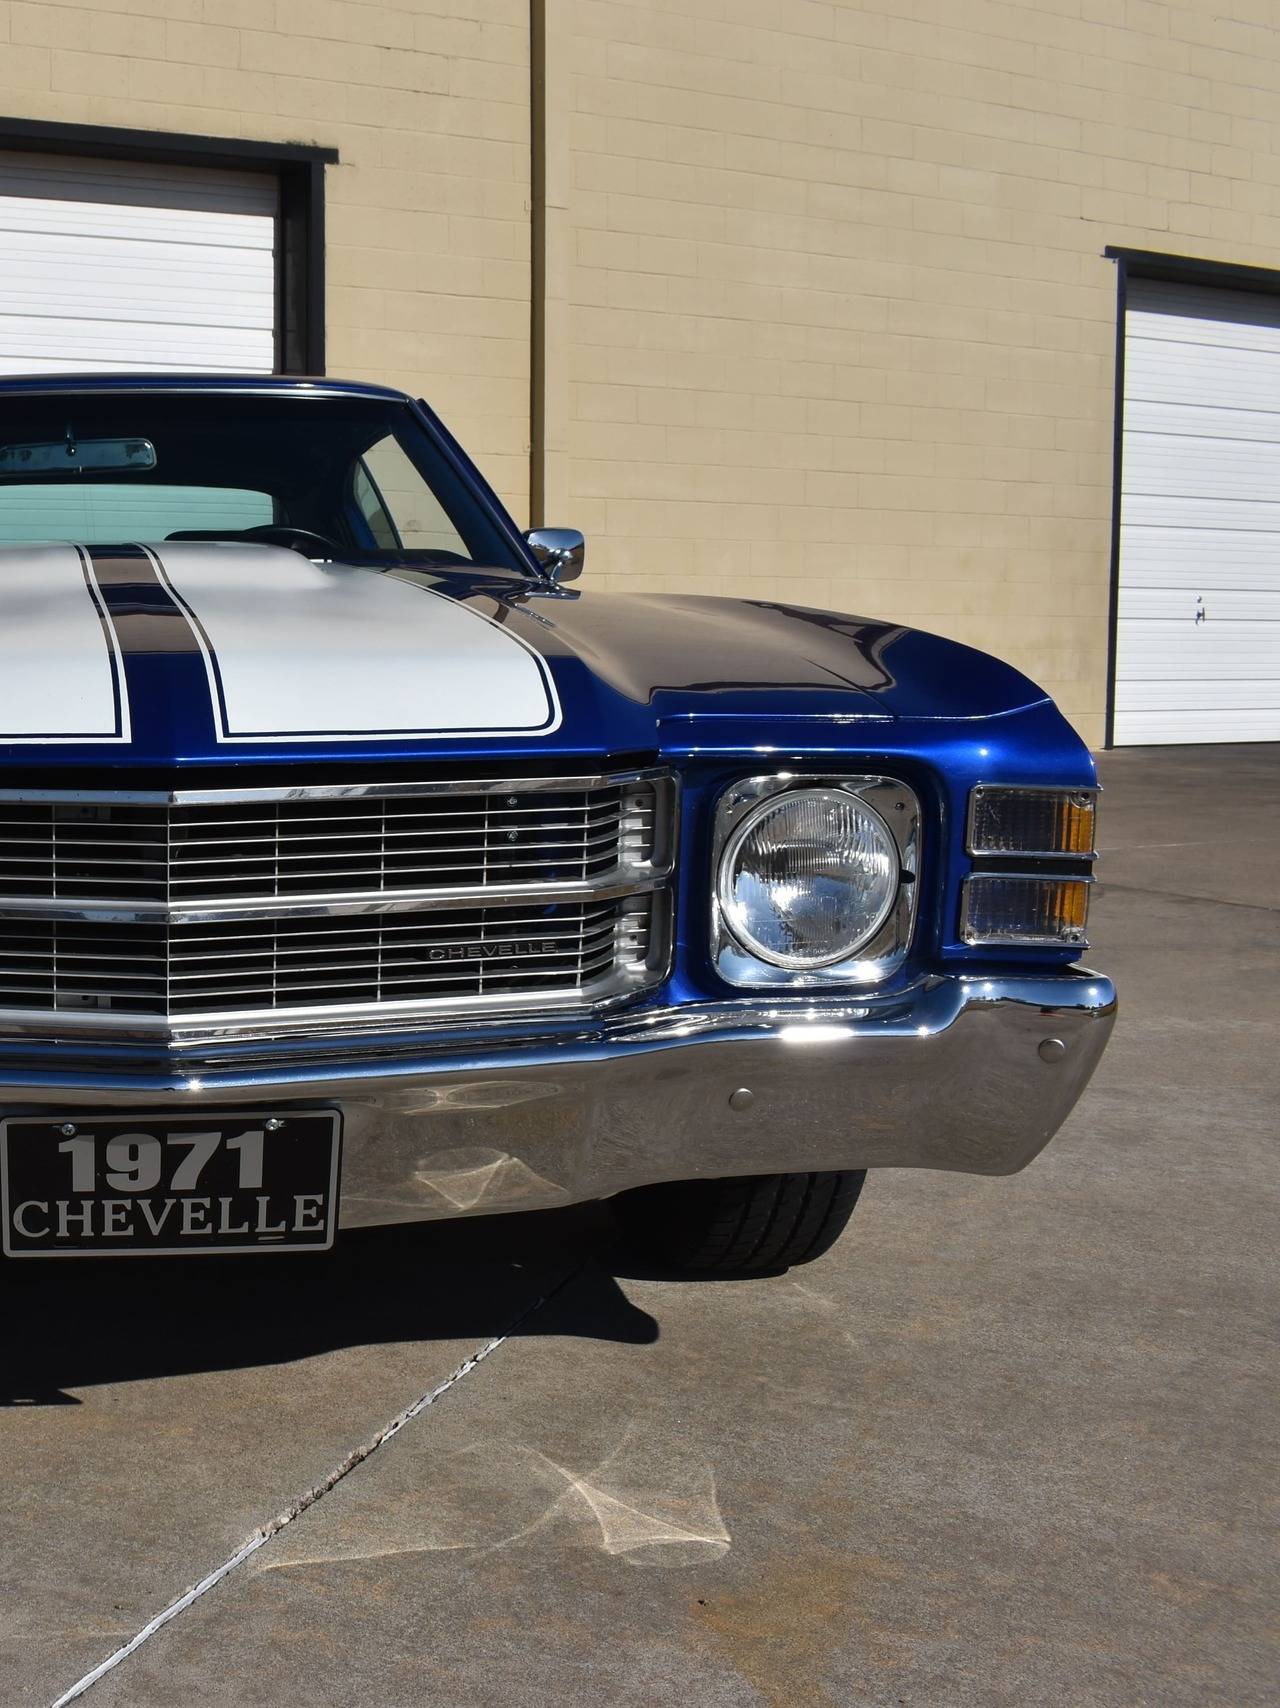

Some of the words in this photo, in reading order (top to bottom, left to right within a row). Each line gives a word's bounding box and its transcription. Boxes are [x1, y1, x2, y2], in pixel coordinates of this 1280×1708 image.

[429, 941, 559, 960] CHEVELLE
[58, 1130, 265, 1193] 1971
[13, 1194, 324, 1238] CHEVELLE
